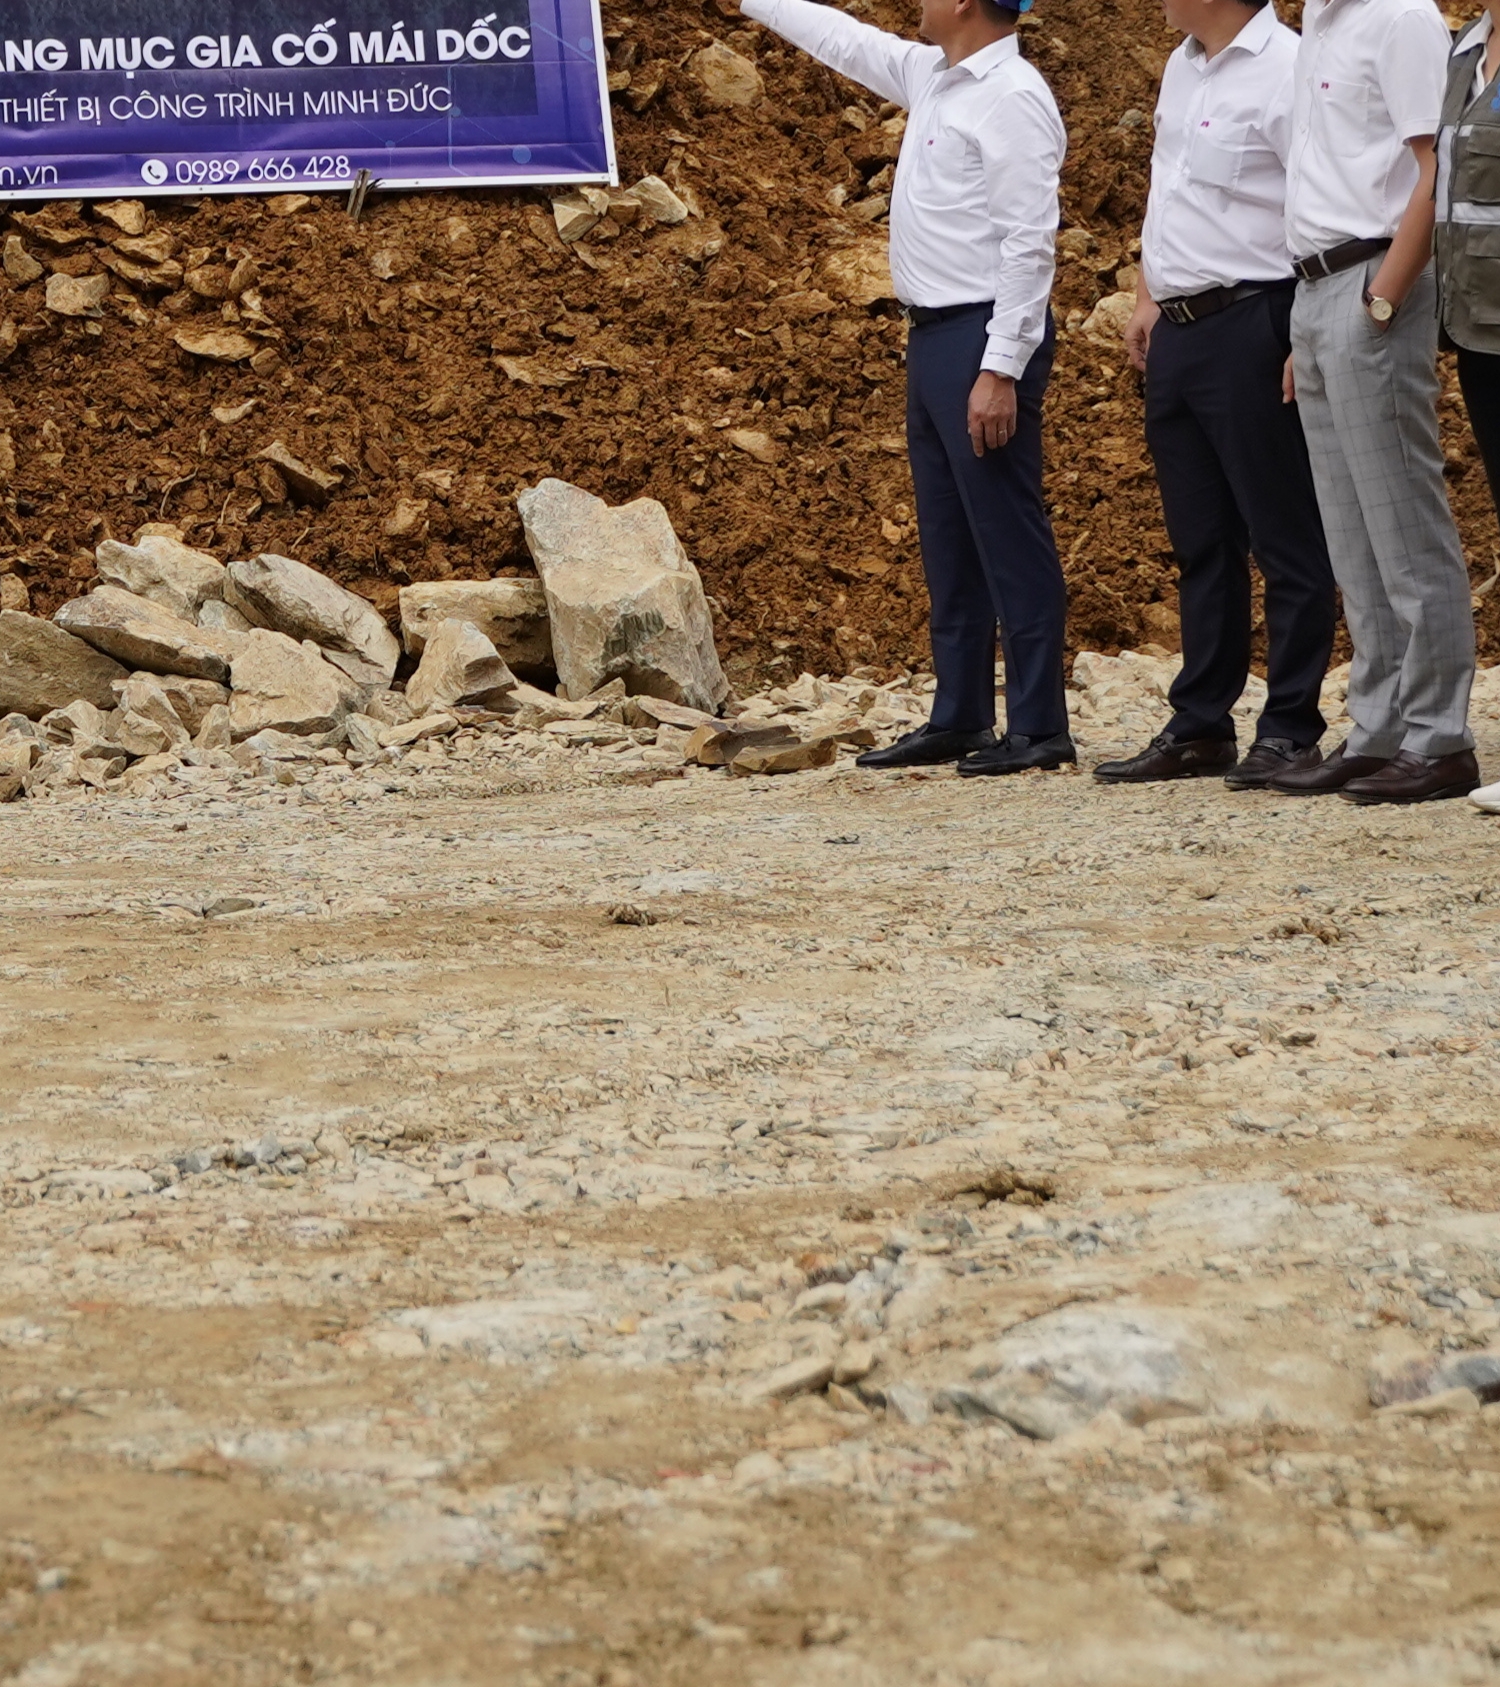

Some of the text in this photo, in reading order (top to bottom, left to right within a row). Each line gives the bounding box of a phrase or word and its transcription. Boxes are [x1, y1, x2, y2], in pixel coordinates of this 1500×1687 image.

[80, 36, 175, 79] MỤC
[186, 34, 263, 68] GIA
[272, 18, 338, 66] CỐ
[350, 21, 425, 64] MÁI
[436, 13, 531, 61] DỐC
[0, 89, 68, 123] THIẾT
[78, 97, 102, 126] BỊ
[109, 90, 206, 120] CÔNG
[214, 88, 294, 118] TRÌNH
[304, 90, 379, 116] MINH
[387, 83, 452, 113] ĐỨC
[175, 159, 239, 183] 0989
[247, 157, 296, 182] 666
[303, 156, 351, 180] 428
